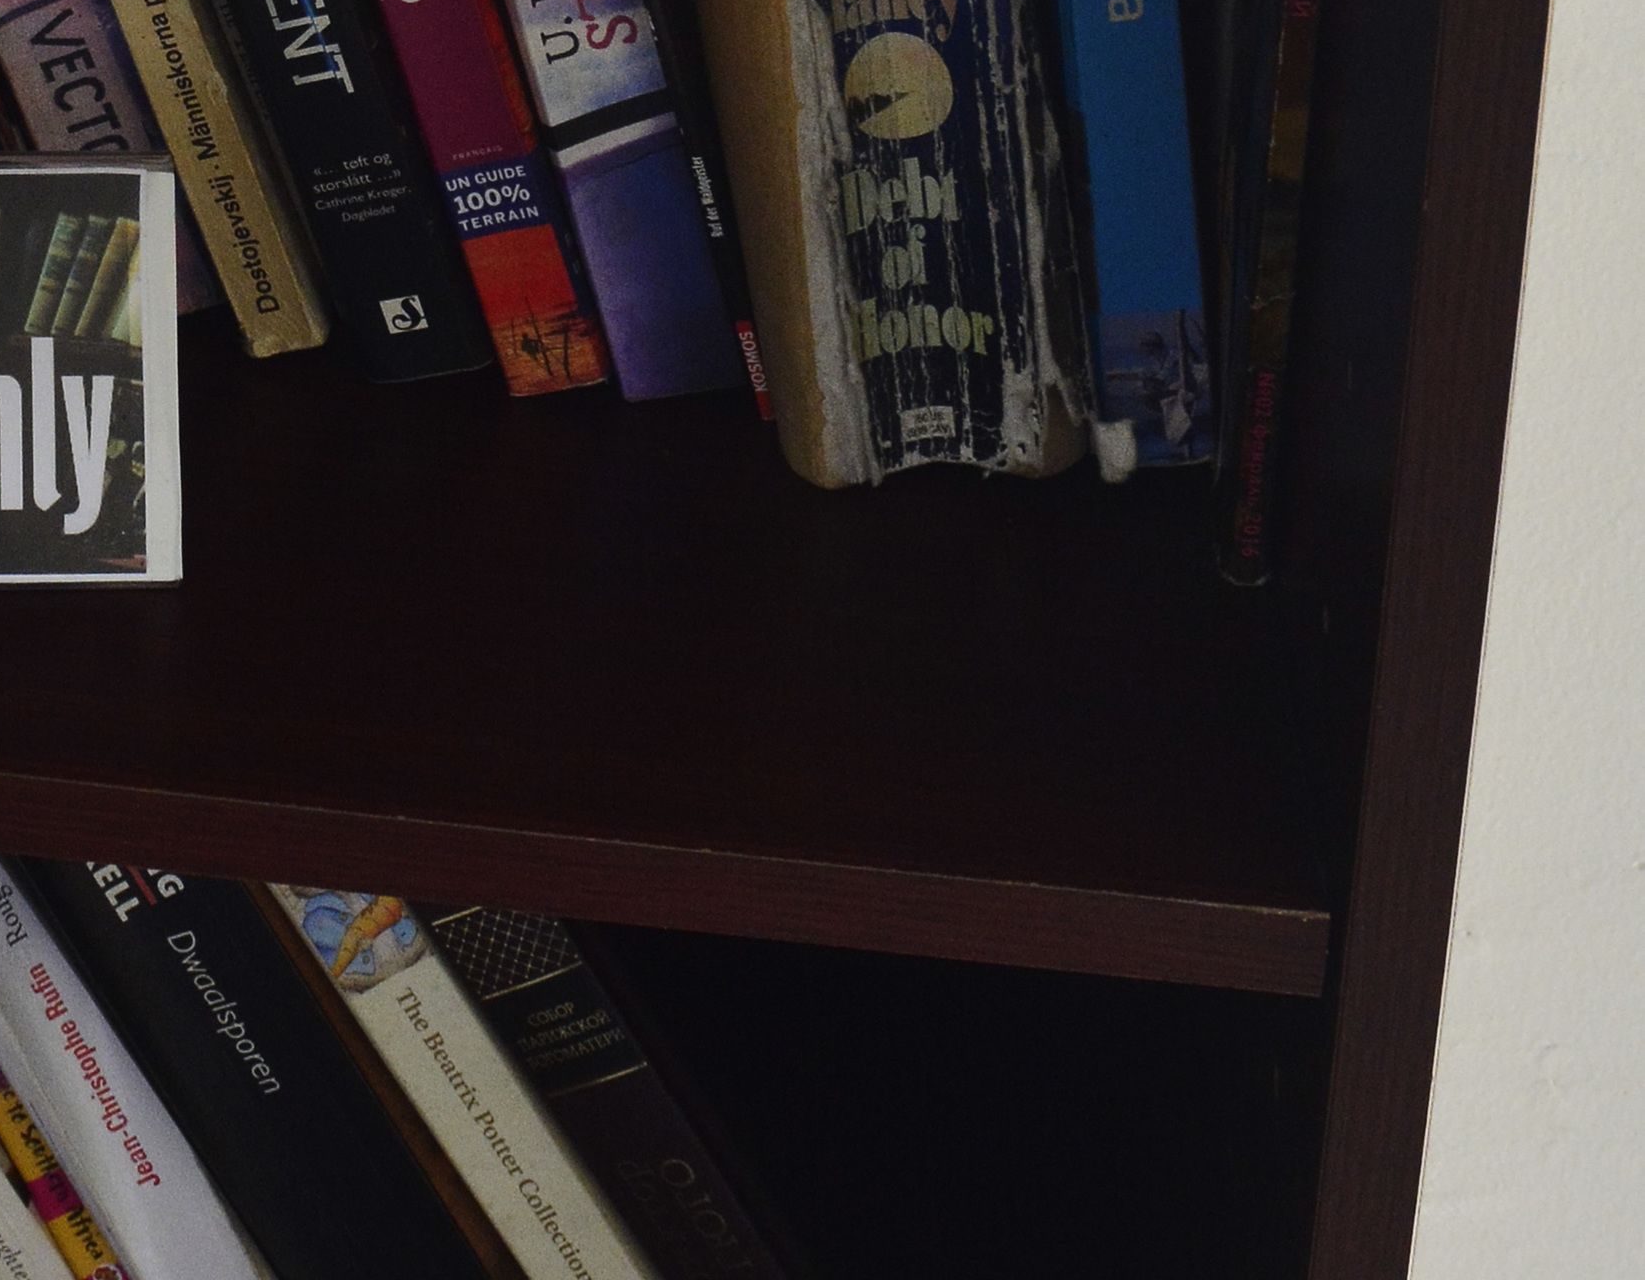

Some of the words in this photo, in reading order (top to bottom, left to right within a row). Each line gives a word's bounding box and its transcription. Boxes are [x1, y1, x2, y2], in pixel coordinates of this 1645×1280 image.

[541, 15, 581, 65] U.
[152, 12, 220, 161] Människorna
[445, 178, 471, 193] UN
[474, 164, 527, 186] GUIDE
[453, 183, 531, 215] 100%
[841, 156, 962, 236] Debt
[205, 173, 281, 316] Dostojevskij
[458, 205, 540, 233] TERRAIN
[880, 222, 929, 291] of
[738, 330, 768, 393] KOSMOS
[29, 962, 68, 1022] Rufin
[166, 929, 282, 1096] Dwaalsporen
[60, 1018, 161, 1188] Jean-Christophe
[395, 987, 430, 1033] The
[424, 1032, 482, 1111] Beatrix
[473, 1110, 524, 1179] Potter
